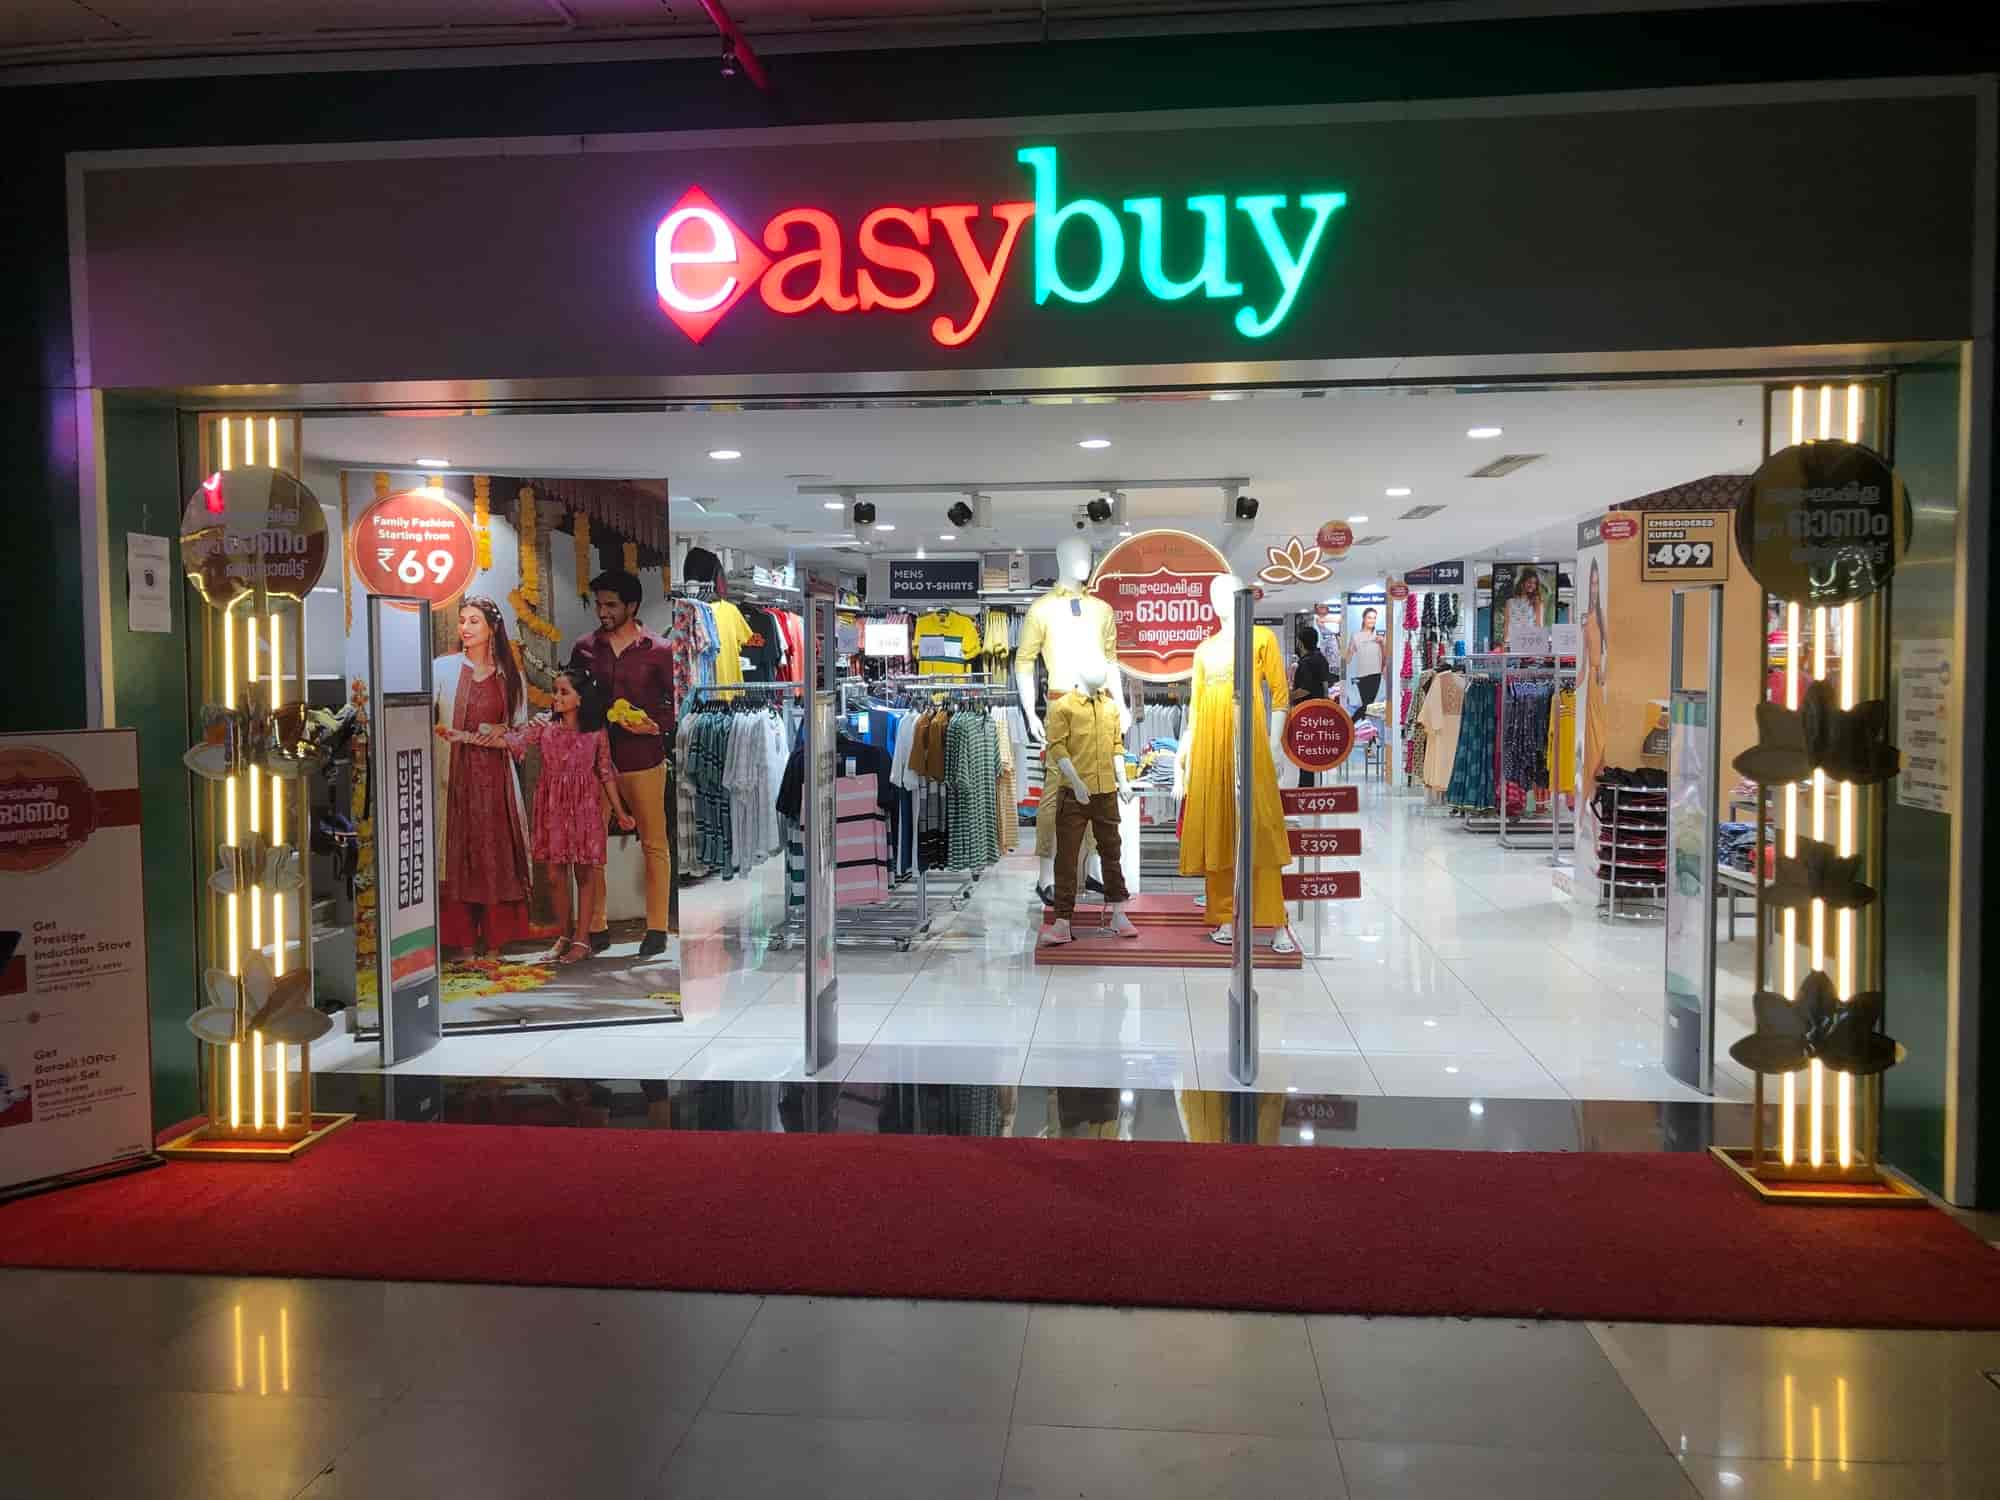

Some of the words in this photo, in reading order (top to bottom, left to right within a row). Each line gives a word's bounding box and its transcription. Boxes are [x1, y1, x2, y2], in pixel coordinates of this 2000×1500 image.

[655, 146, 1347, 346] easybuy
[373, 515, 409, 528] Family
[411, 517, 455, 528] Fashion
[378, 529, 423, 542] Starting
[424, 530, 450, 541] from
[894, 570, 924, 579] MENS
[894, 582, 924, 590] POLO
[926, 582, 974, 590] T-SHIRTS
[1136, 599, 1213, 623] ഓണം
[1300, 716, 1335, 729] Styles
[1295, 731, 1315, 741] For
[1316, 730, 1340, 741] This
[1297, 743, 1339, 755] Festive
[399, 753, 410, 824] PRICE
[412, 751, 423, 820] STYLE
[1300, 839, 1338, 852] ₹399
[399, 829, 410, 903] SUPER
[412, 825, 424, 902] SUPER
[1300, 883, 1338, 896] ₹349
[33, 920, 57, 932] Get
[34, 933, 86, 945] Prestige
[34, 945, 95, 960] Induction
[97, 940, 131, 953] Stove
[33, 1049, 57, 1061] Get
[80, 1069, 100, 1080] Set
